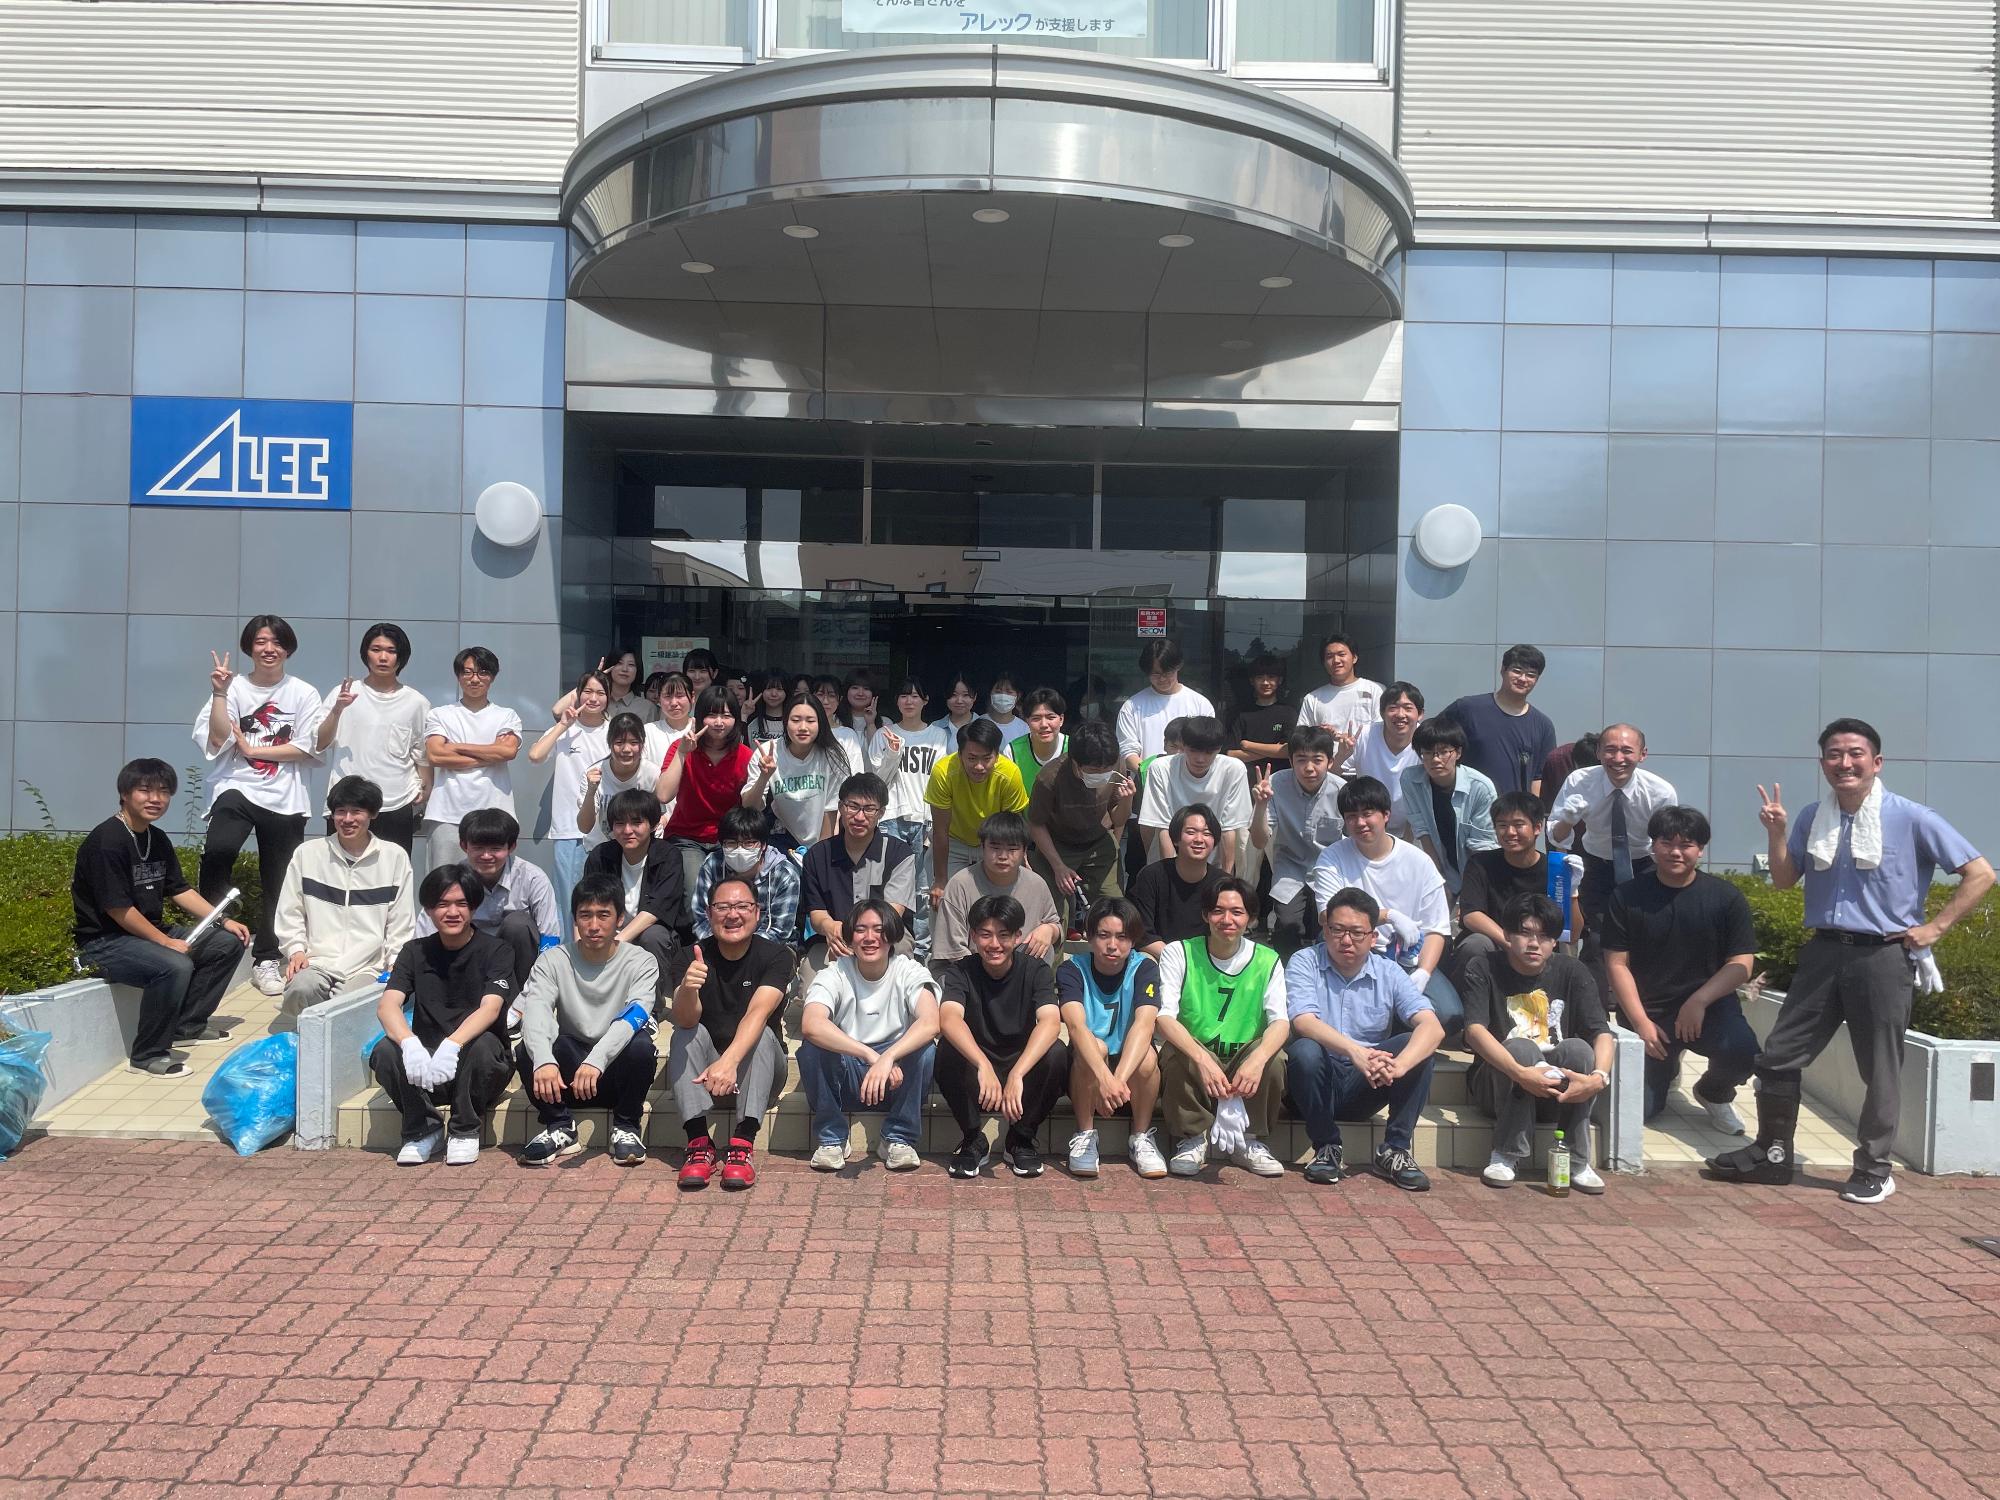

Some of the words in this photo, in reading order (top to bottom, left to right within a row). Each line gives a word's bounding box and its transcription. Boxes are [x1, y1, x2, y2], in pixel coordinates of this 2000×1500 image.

[959, 12, 1115, 32] アレックが支援します
[1145, 983, 1155, 998] 4
[1217, 986, 1236, 1023] 7
[1103, 1001, 1121, 1037] 7
